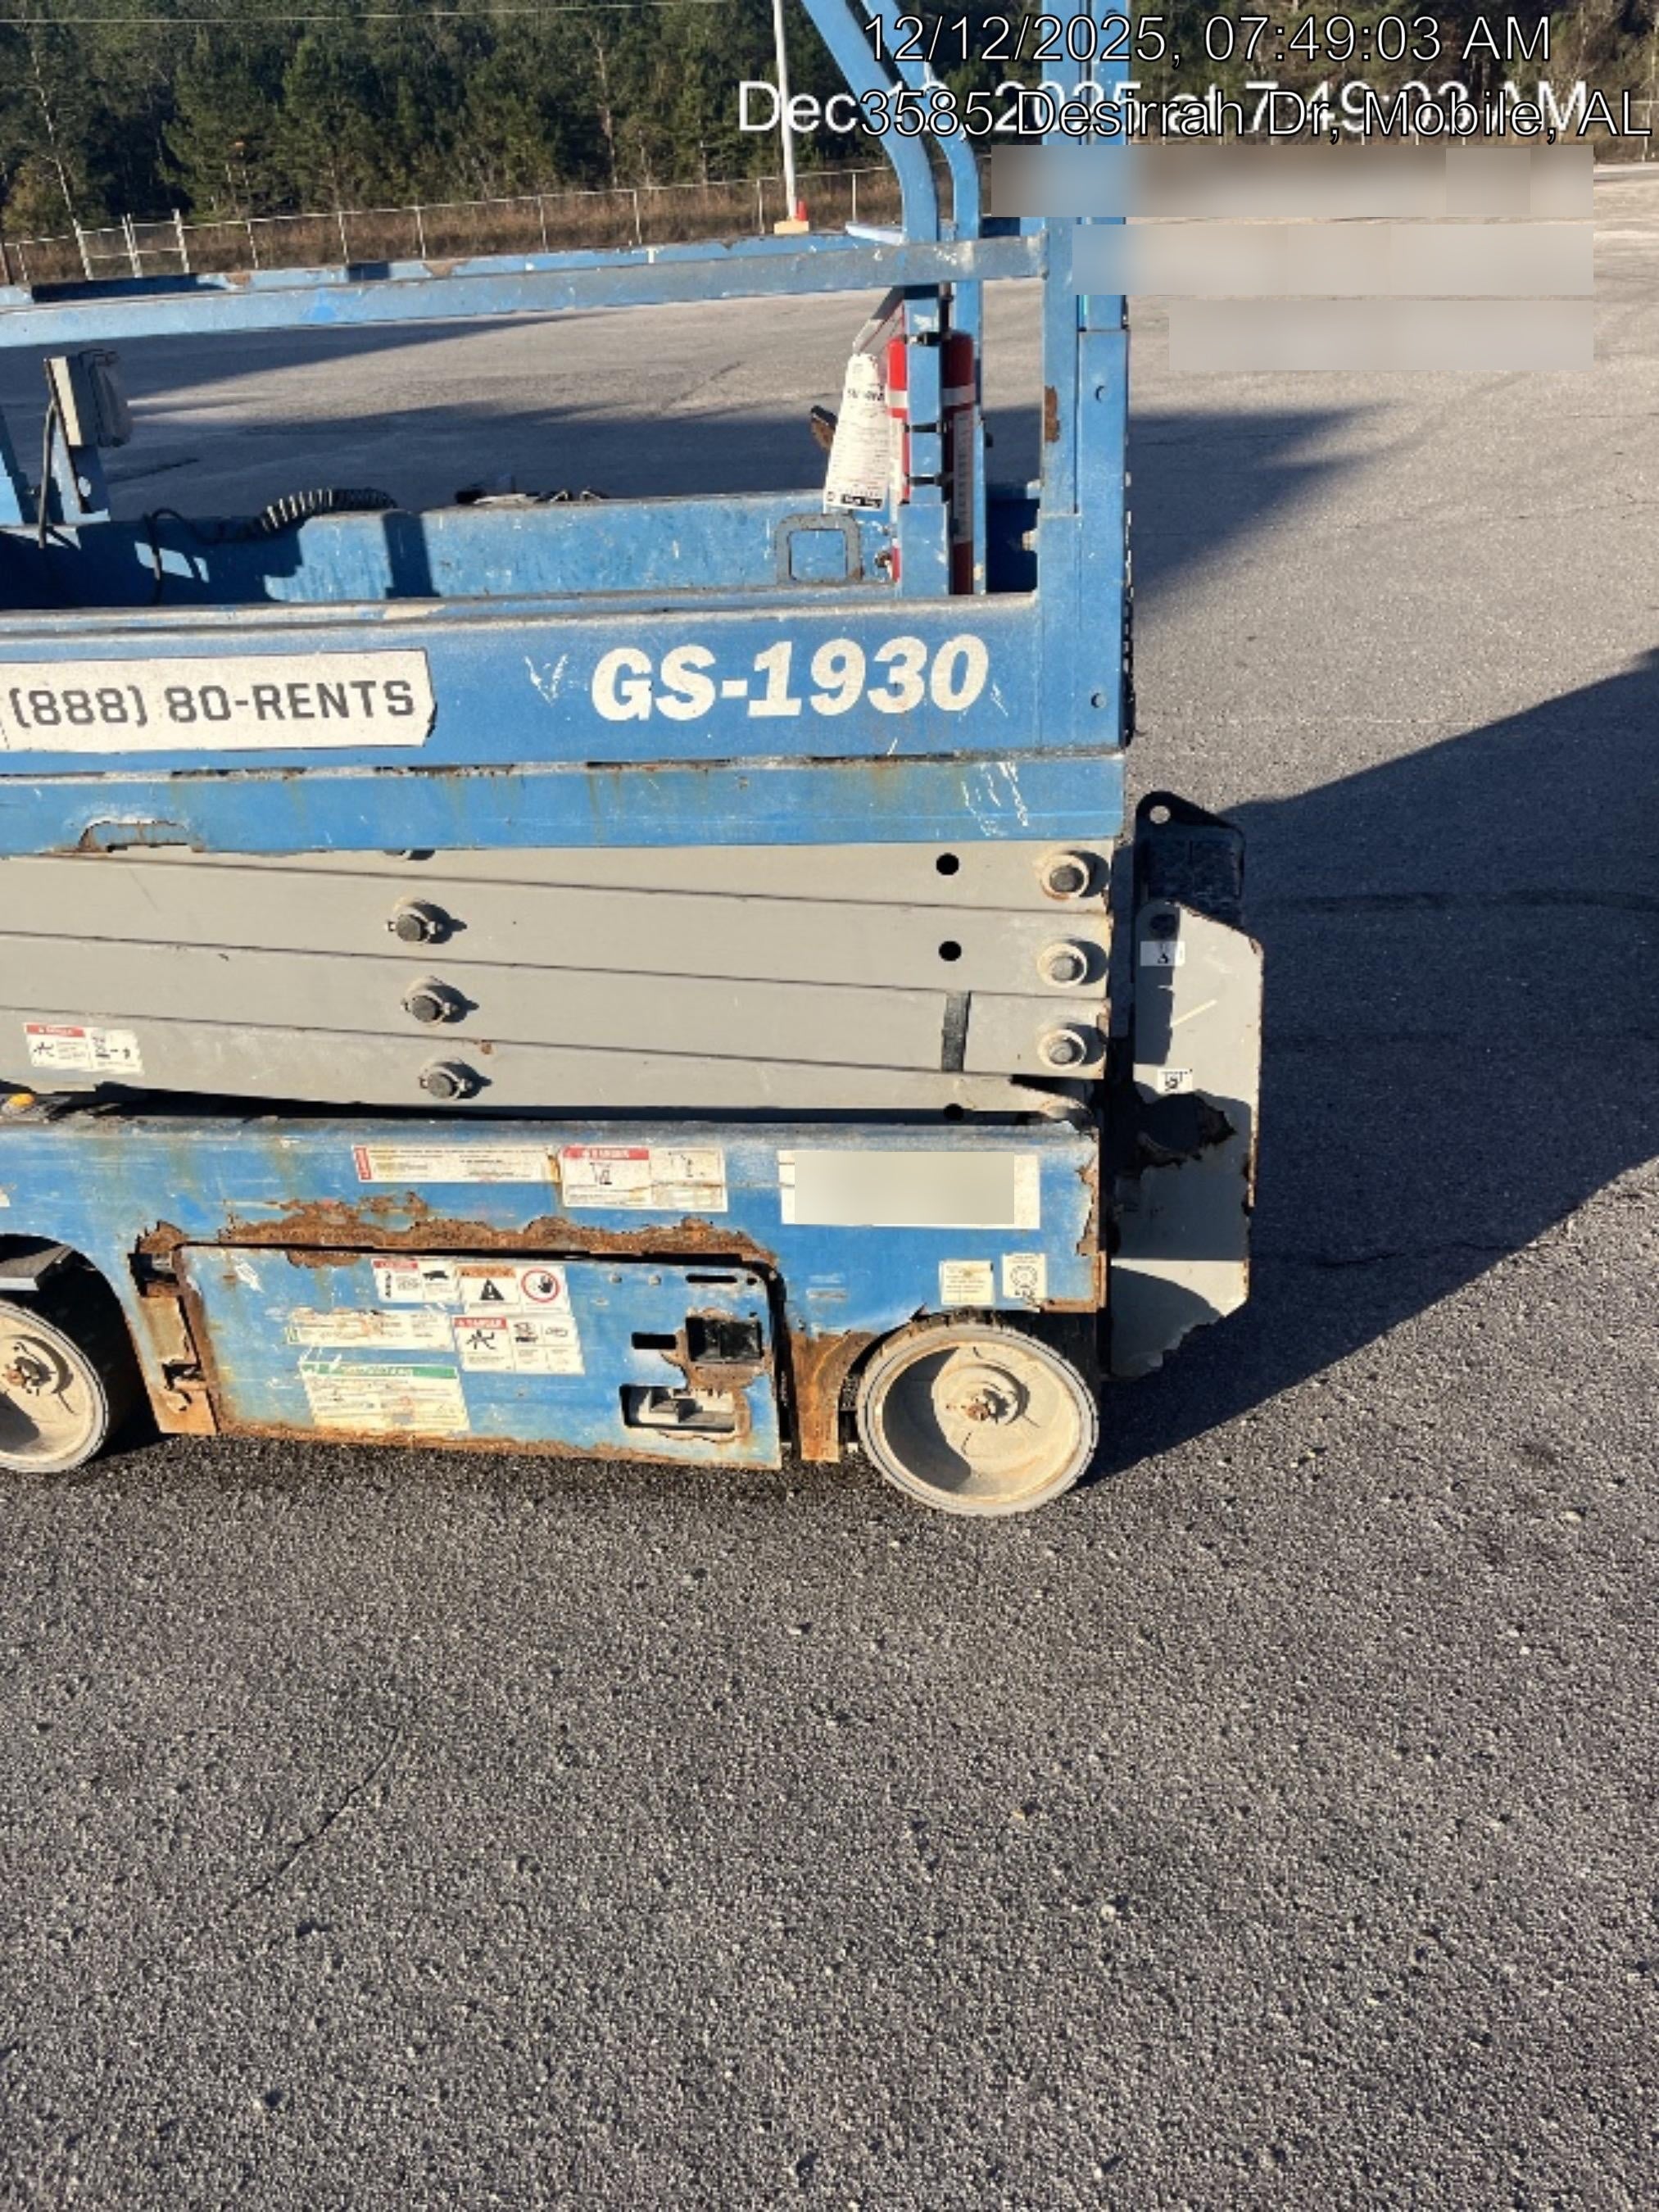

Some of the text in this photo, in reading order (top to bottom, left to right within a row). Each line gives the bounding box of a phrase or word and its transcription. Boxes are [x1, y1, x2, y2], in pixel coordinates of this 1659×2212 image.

[8, 680, 415, 728] (888) 80-RENTS
[591, 633, 989, 721] GS-1930
